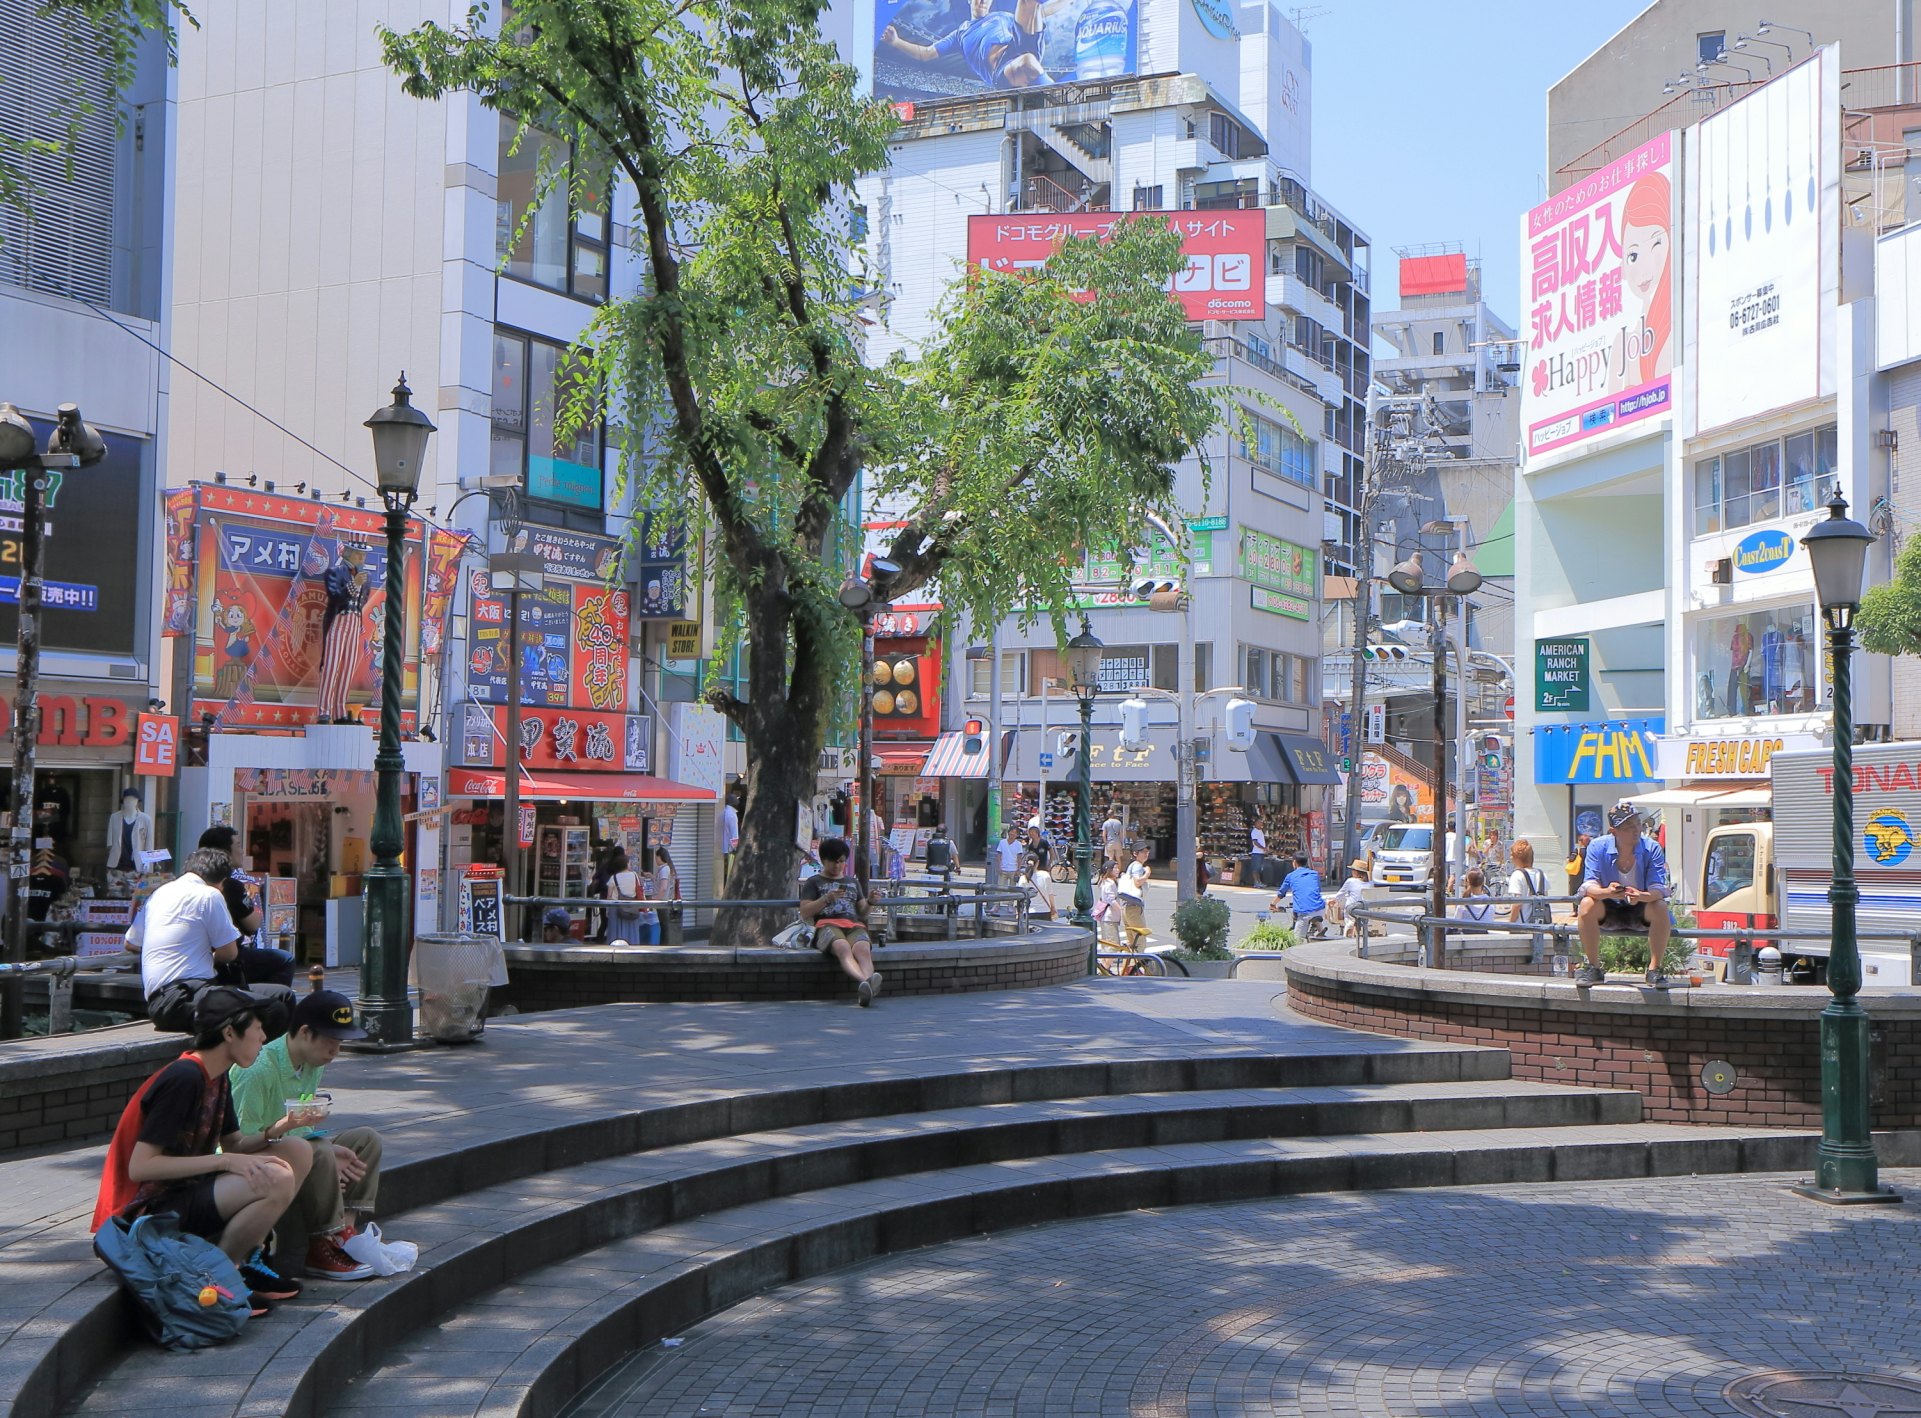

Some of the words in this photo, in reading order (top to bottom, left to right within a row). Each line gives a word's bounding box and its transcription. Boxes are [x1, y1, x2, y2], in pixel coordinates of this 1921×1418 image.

[1077, 20, 1127, 41] AQUARIUS
[1531, 201, 1622, 302] 高収入
[1207, 298, 1252, 308] docomo
[1531, 264, 1622, 351] 求人情報
[1729, 294, 1780, 329] 06-6727-0601
[1548, 345, 1612, 396] Happy
[1618, 317, 1654, 377] Job
[1620, 389, 1666, 414] http://hjob.jp
[229, 535, 300, 570] アメ村
[671, 624, 699, 638] WALKIN
[588, 624, 614, 687] 40周年
[672, 640, 696, 653] STORE
[1540, 644, 1585, 656] AMERICAN
[1544, 671, 1580, 682] MARKET
[1547, 658, 1577, 669] RANCH
[1543, 692, 1554, 703] 2F
[467, 742, 488, 758] 本店
[517, 716, 616, 763] 甲賀流
[1111, 760, 1121, 768] to
[1567, 731, 1653, 779] FHM
[1686, 742, 1740, 775] FRESH
[1816, 761, 1921, 795] TONA
[474, 899, 486, 932] ベース
[486, 898, 498, 932] アメ村
[89, 936, 122, 946] 10%OFF
